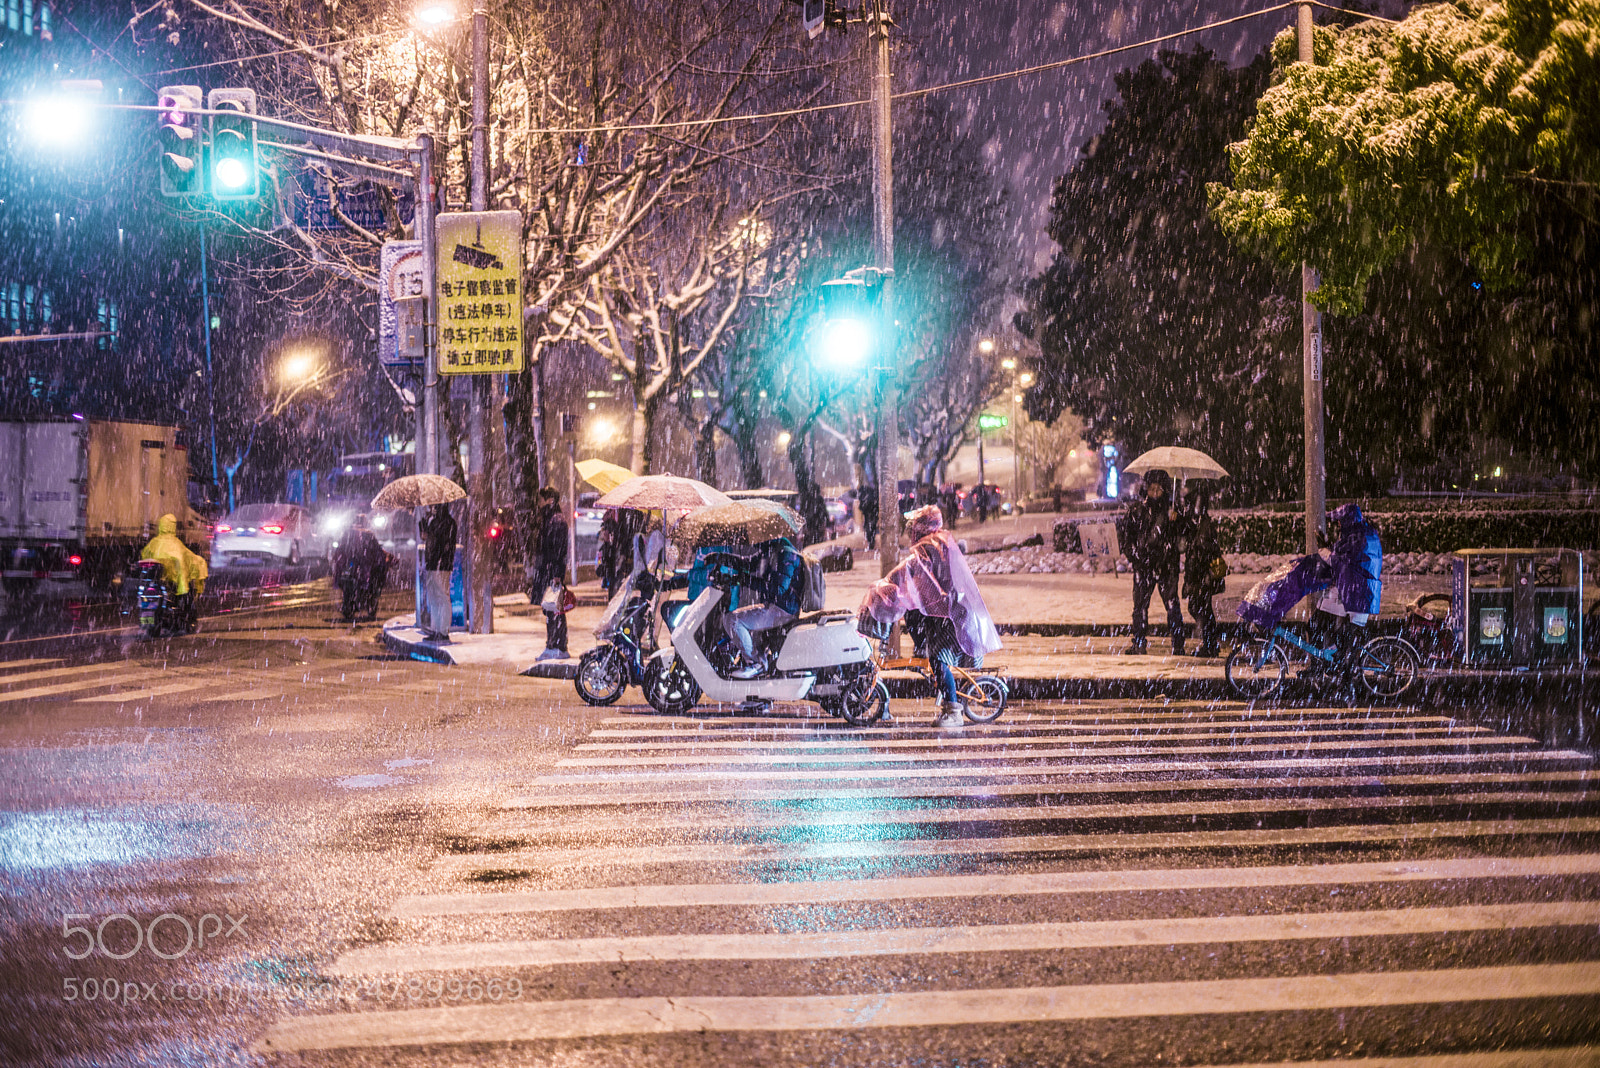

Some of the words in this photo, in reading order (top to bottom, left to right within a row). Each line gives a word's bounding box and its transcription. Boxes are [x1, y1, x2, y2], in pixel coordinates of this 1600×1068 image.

[441, 278, 517, 297] 电子警察监管
[442, 325, 518, 344] 停车行为违法
[447, 348, 514, 366] 请立即驶离
